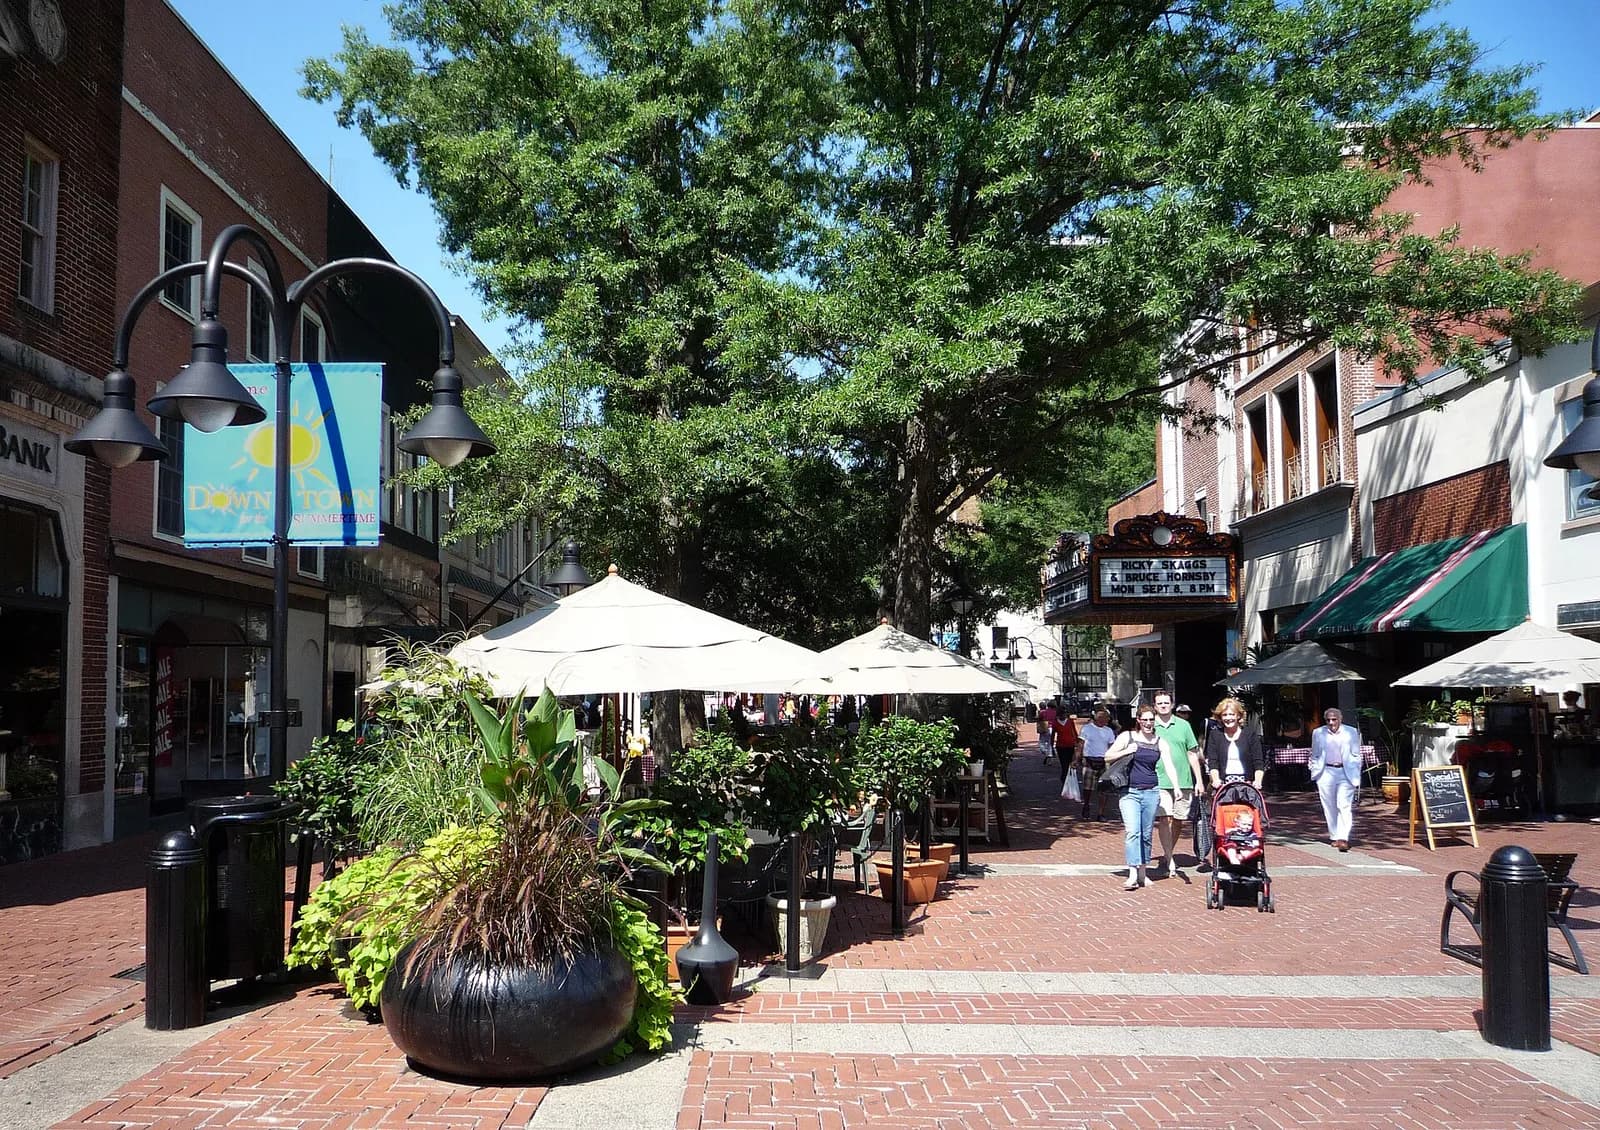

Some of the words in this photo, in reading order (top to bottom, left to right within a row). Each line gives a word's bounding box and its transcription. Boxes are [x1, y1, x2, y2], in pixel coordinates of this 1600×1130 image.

[297, 490, 375, 510] TOWN
[1121, 560, 1153, 570] RICKY
[1161, 559, 1207, 570] SKAGGS
[1110, 572, 1118, 582] &
[1125, 572, 1159, 582] BRUCE
[1166, 571, 1216, 582] HORNSBY
[1111, 584, 1135, 594] MON
[1142, 584, 1170, 594] SEPT
[1424, 770, 1460, 786] Specials
